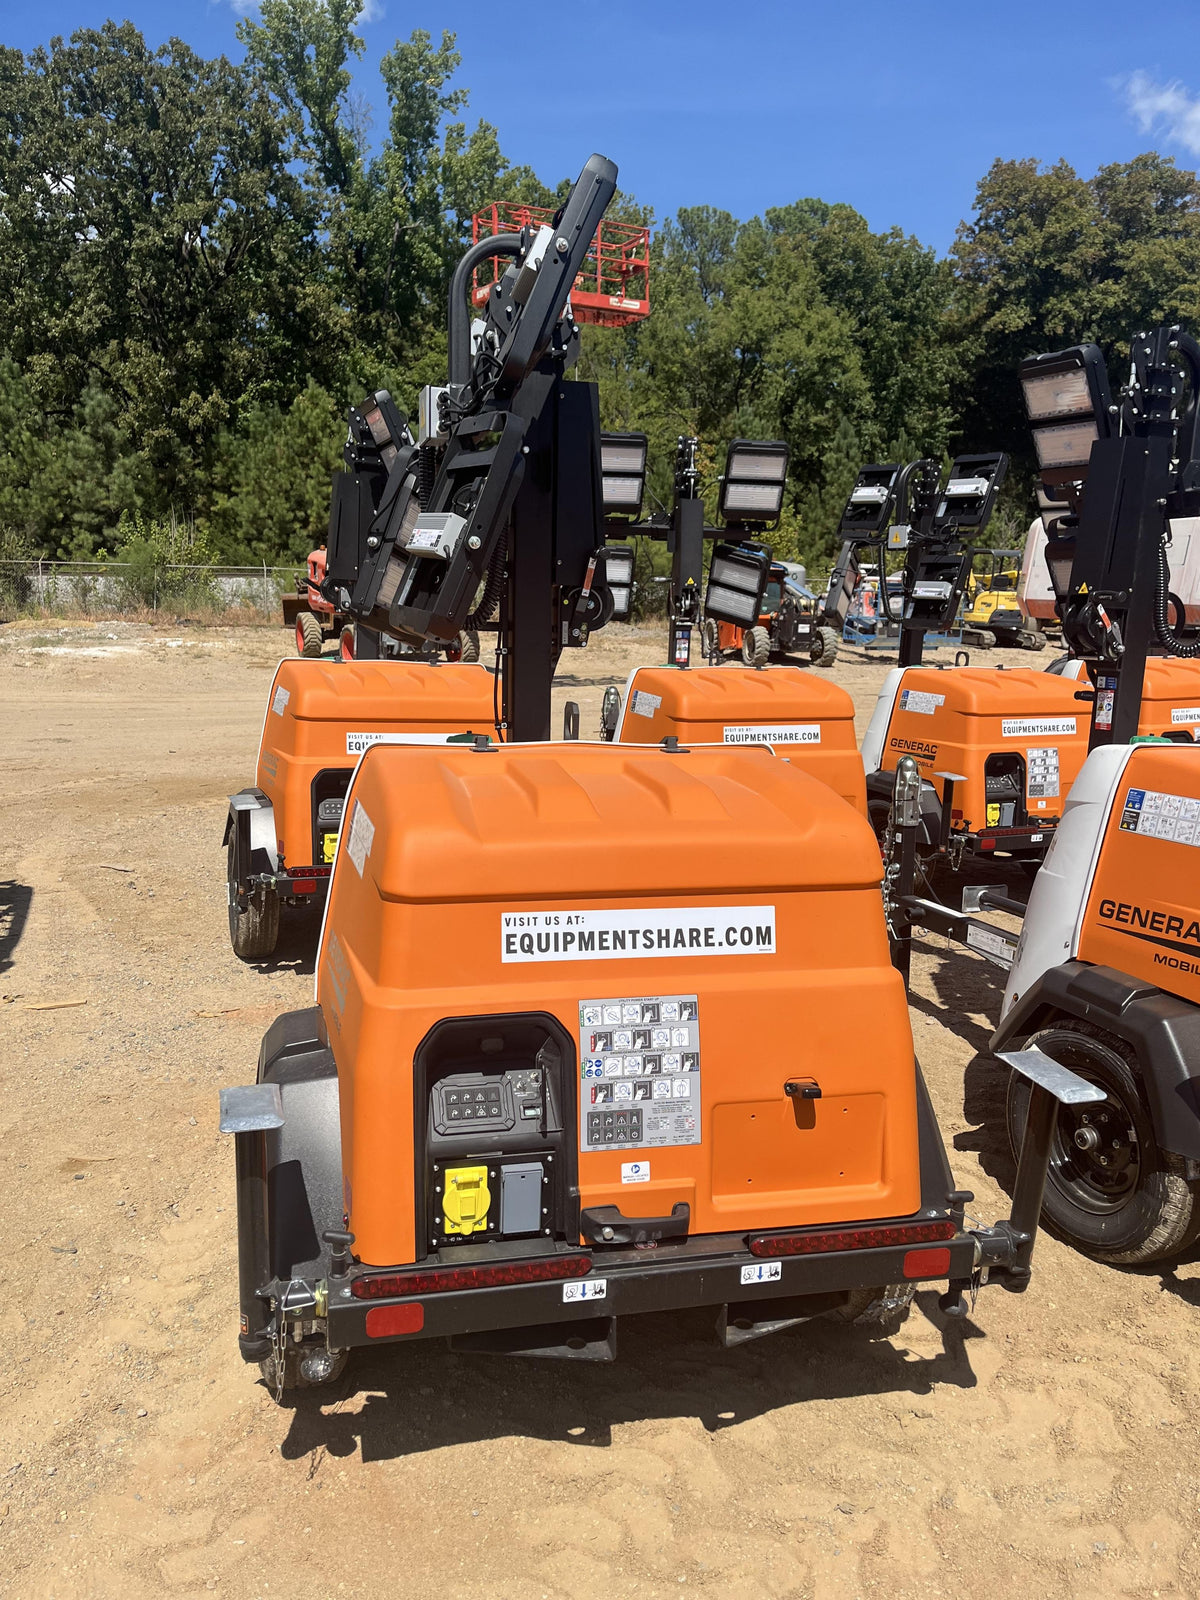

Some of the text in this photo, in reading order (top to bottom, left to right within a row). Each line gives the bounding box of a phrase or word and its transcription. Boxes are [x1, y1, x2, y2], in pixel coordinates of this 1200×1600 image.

[1003, 724, 1076, 734] EQUIPMENTSHARE.COM
[725, 732, 820, 743] EQUIPMENTSHARE.COM
[890, 737, 938, 754] GENERAC
[504, 915, 585, 927] VISIT US AT:
[505, 926, 772, 955] EQUIPMENTSHARE.COM
